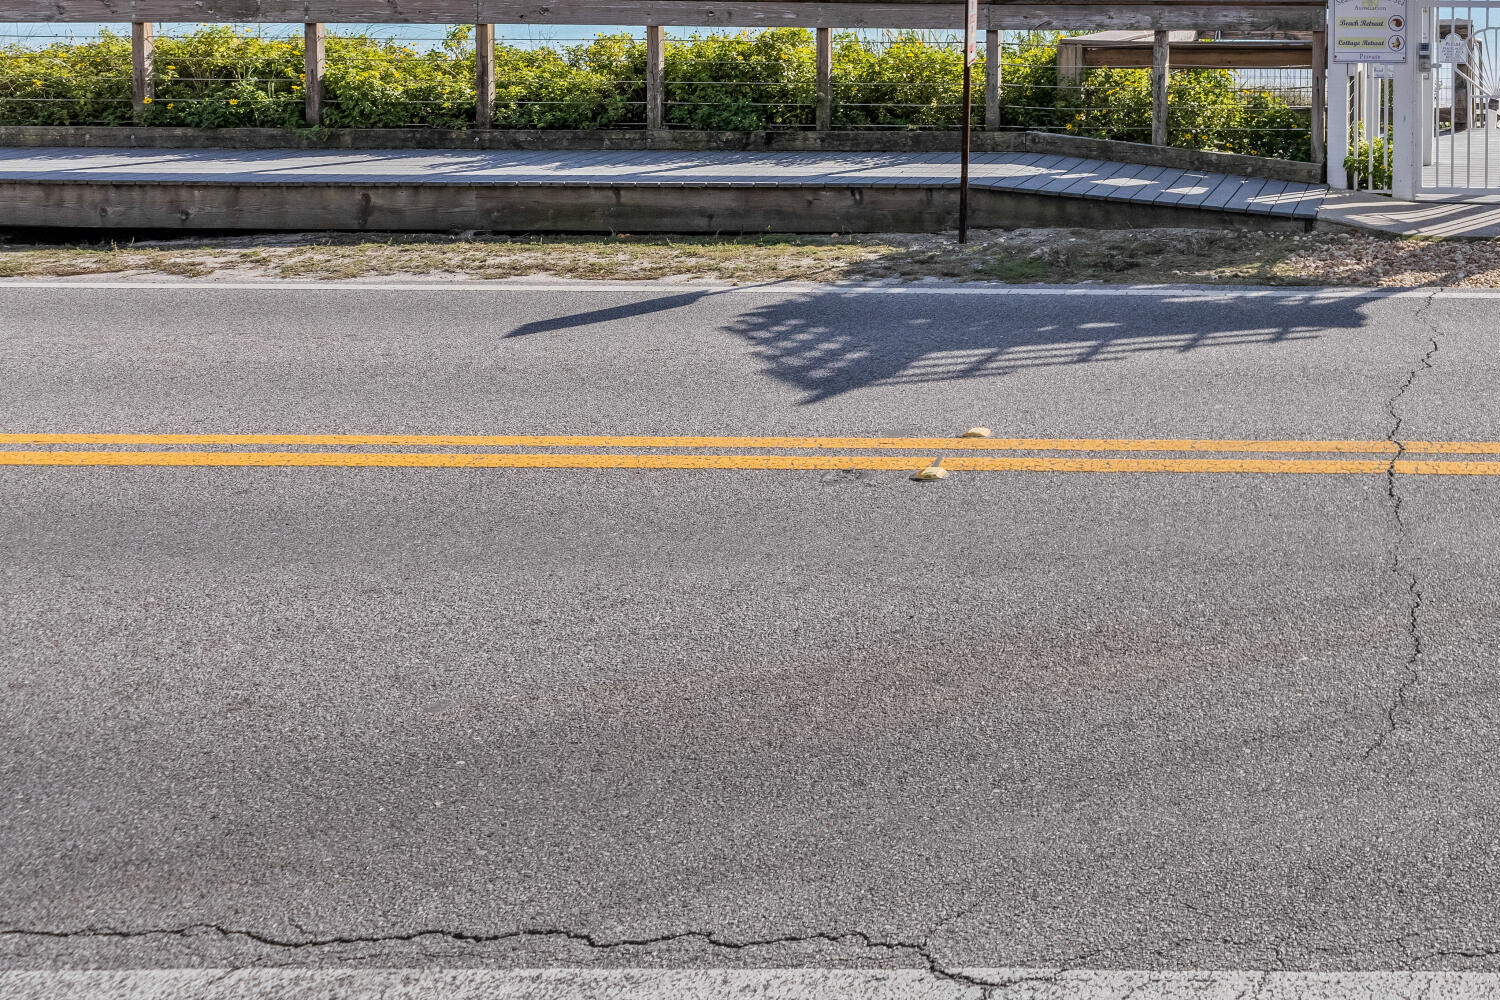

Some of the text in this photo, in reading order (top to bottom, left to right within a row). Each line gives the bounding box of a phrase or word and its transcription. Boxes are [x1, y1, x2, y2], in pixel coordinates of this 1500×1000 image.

[1339, 19, 1384, 27] Beach Retreat
[1338, 39, 1360, 48] Cottage
